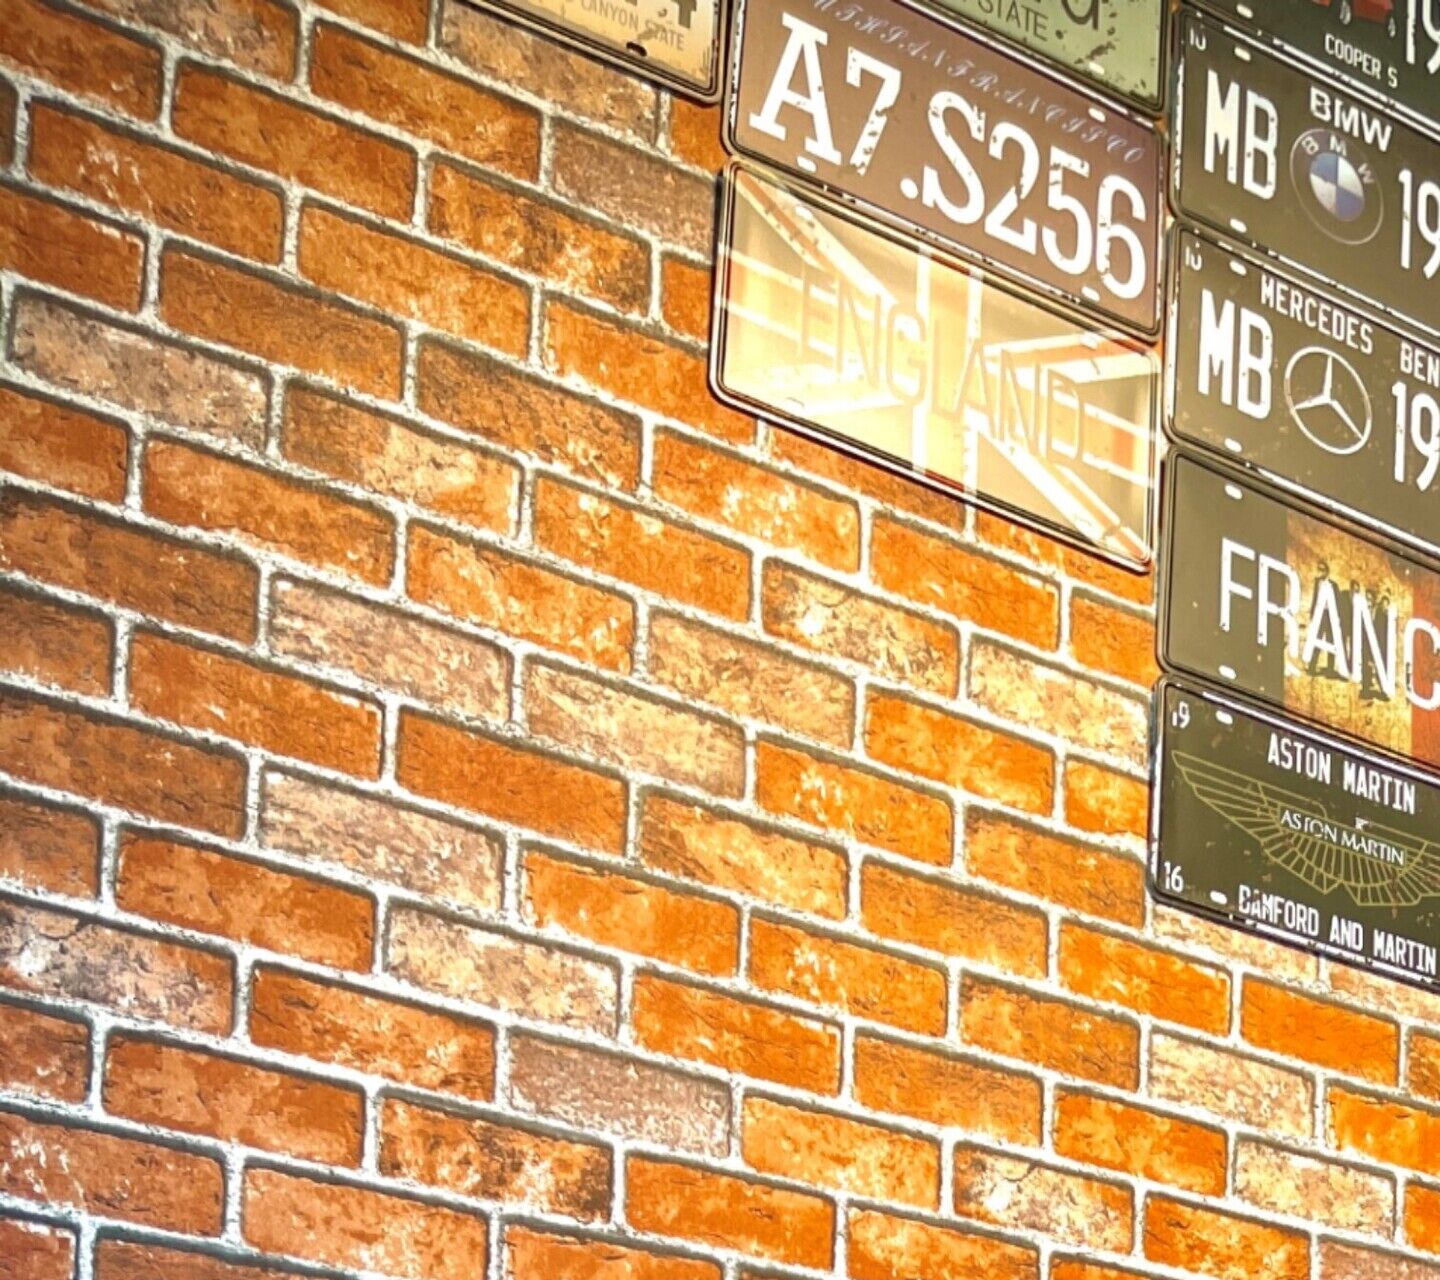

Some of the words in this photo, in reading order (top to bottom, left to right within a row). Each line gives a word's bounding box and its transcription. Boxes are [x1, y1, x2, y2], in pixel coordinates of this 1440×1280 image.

[1324, 32, 1382, 81] COOPER
[1387, 65, 1398, 88] S
[1203, 67, 1279, 201] MB
[1309, 86, 1393, 152] BMW
[1260, 272, 1374, 356] MERCEDES
[798, 270, 1088, 462] ENGLAND
[1198, 288, 1273, 420] MB
[1267, 738, 1332, 785] ASTON
[1342, 760, 1417, 816] MARTIN
[1280, 808, 1338, 843] ASTON
[1340, 829, 1406, 866] MARTIN
[1328, 915, 1364, 951] AND
[1373, 930, 1438, 976] MARTIN
